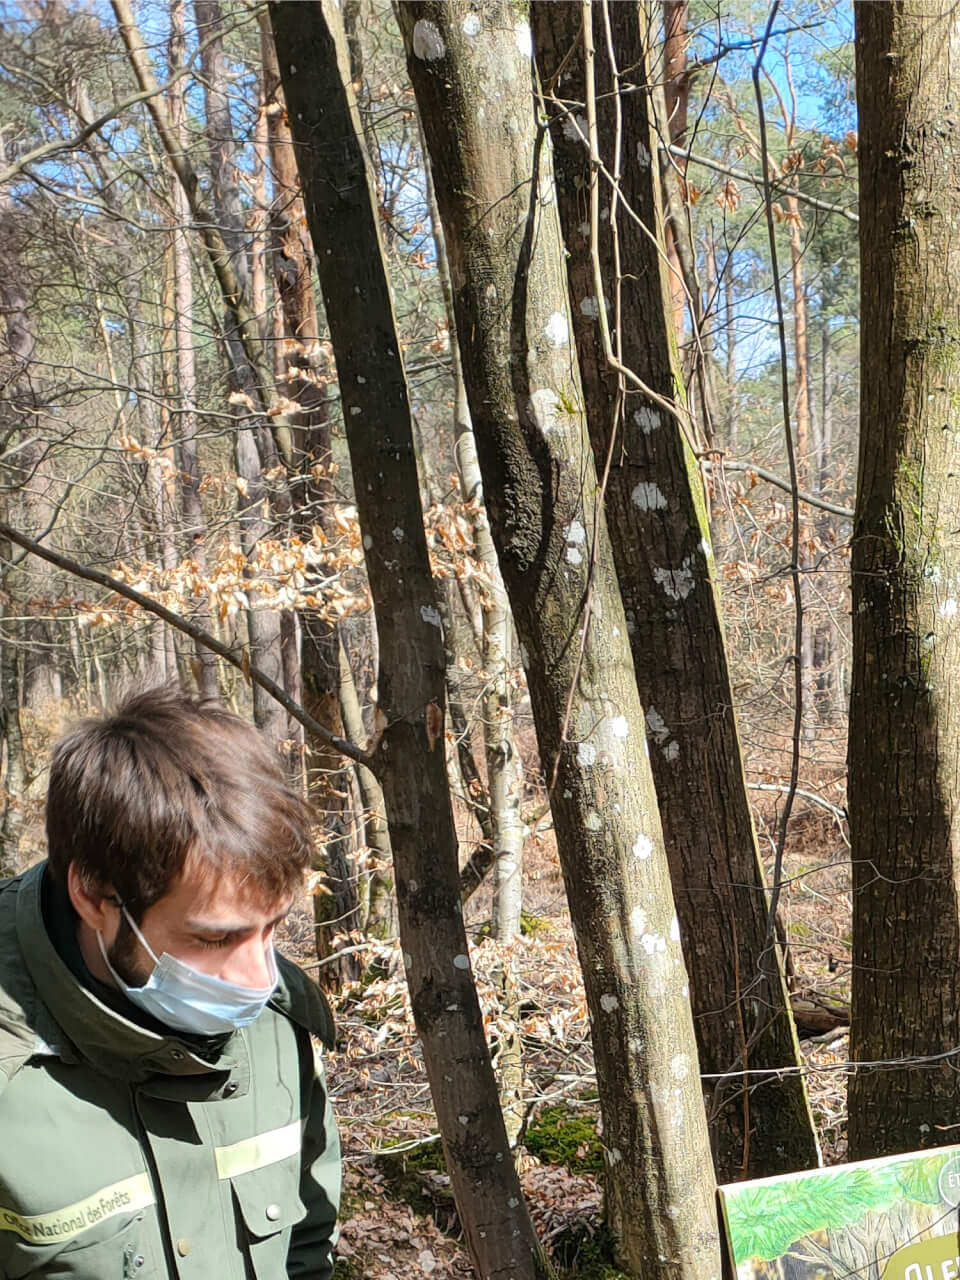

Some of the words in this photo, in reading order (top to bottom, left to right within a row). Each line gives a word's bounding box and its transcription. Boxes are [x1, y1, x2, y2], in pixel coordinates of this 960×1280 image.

[32, 1211, 86, 1238] National
[87, 1206, 102, 1223] des
[99, 1192, 131, 1215] Forêts
